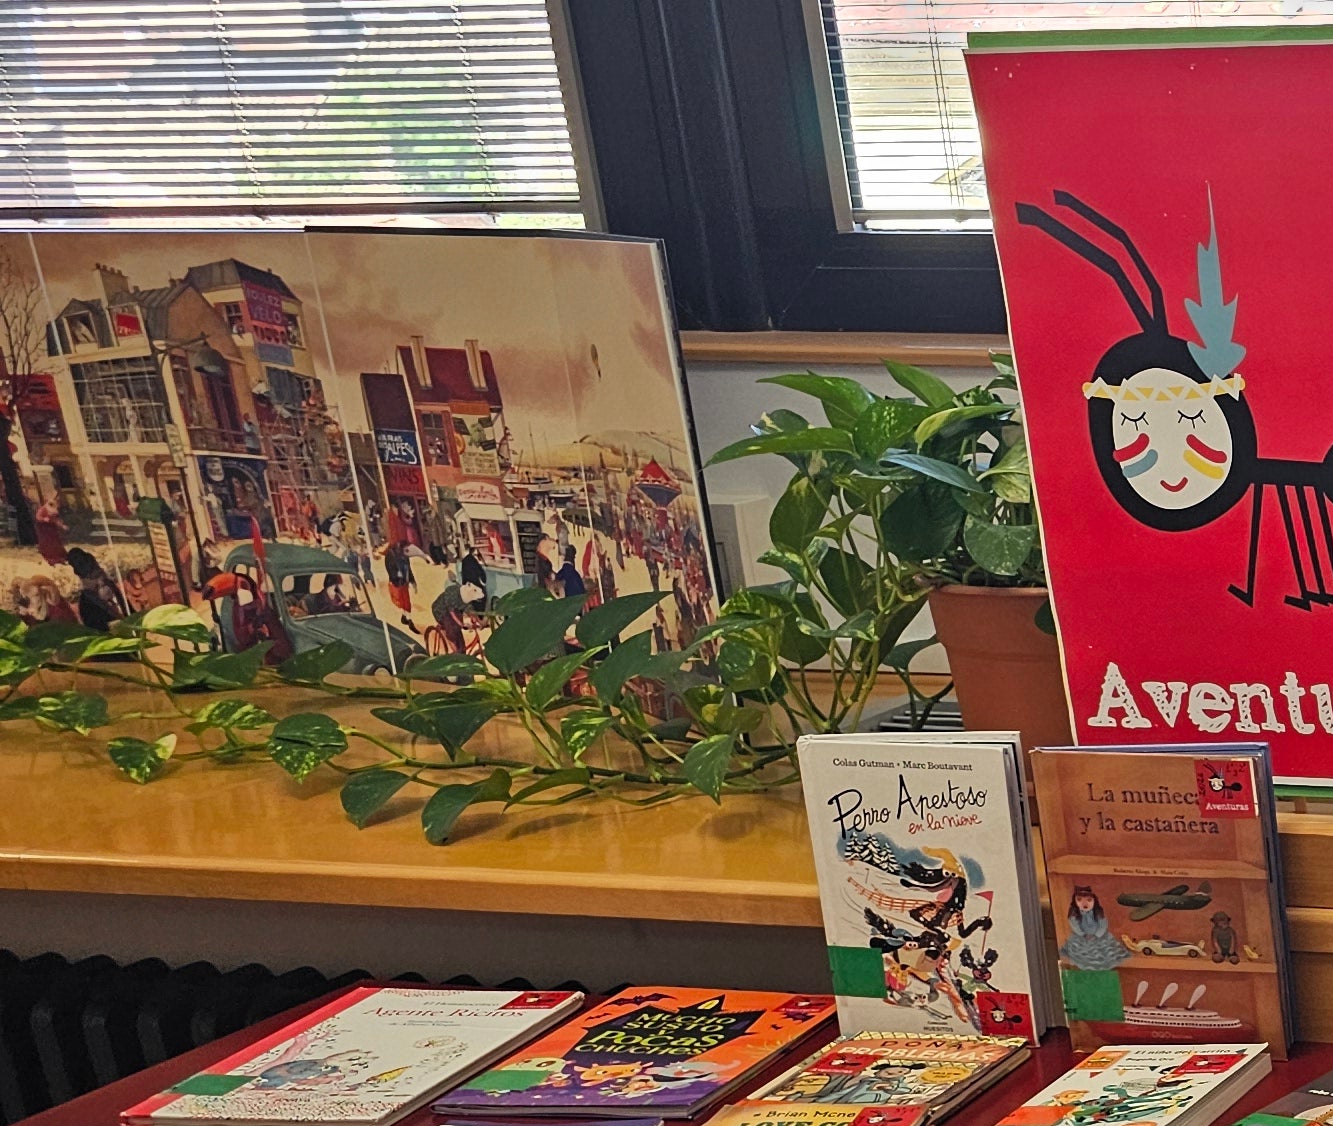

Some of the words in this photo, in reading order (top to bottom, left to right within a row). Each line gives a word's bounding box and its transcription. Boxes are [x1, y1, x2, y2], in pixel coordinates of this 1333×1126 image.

[1087, 782, 1117, 803] La
[1121, 784, 1201, 806] muñec
[827, 788, 892, 840] Perro
[896, 774, 988, 821] Apestoso
[907, 822, 925, 834] en
[926, 813, 943, 829] la
[1079, 816, 1091, 835] y
[1097, 812, 1117, 831] la
[1122, 814, 1220, 835] castañera
